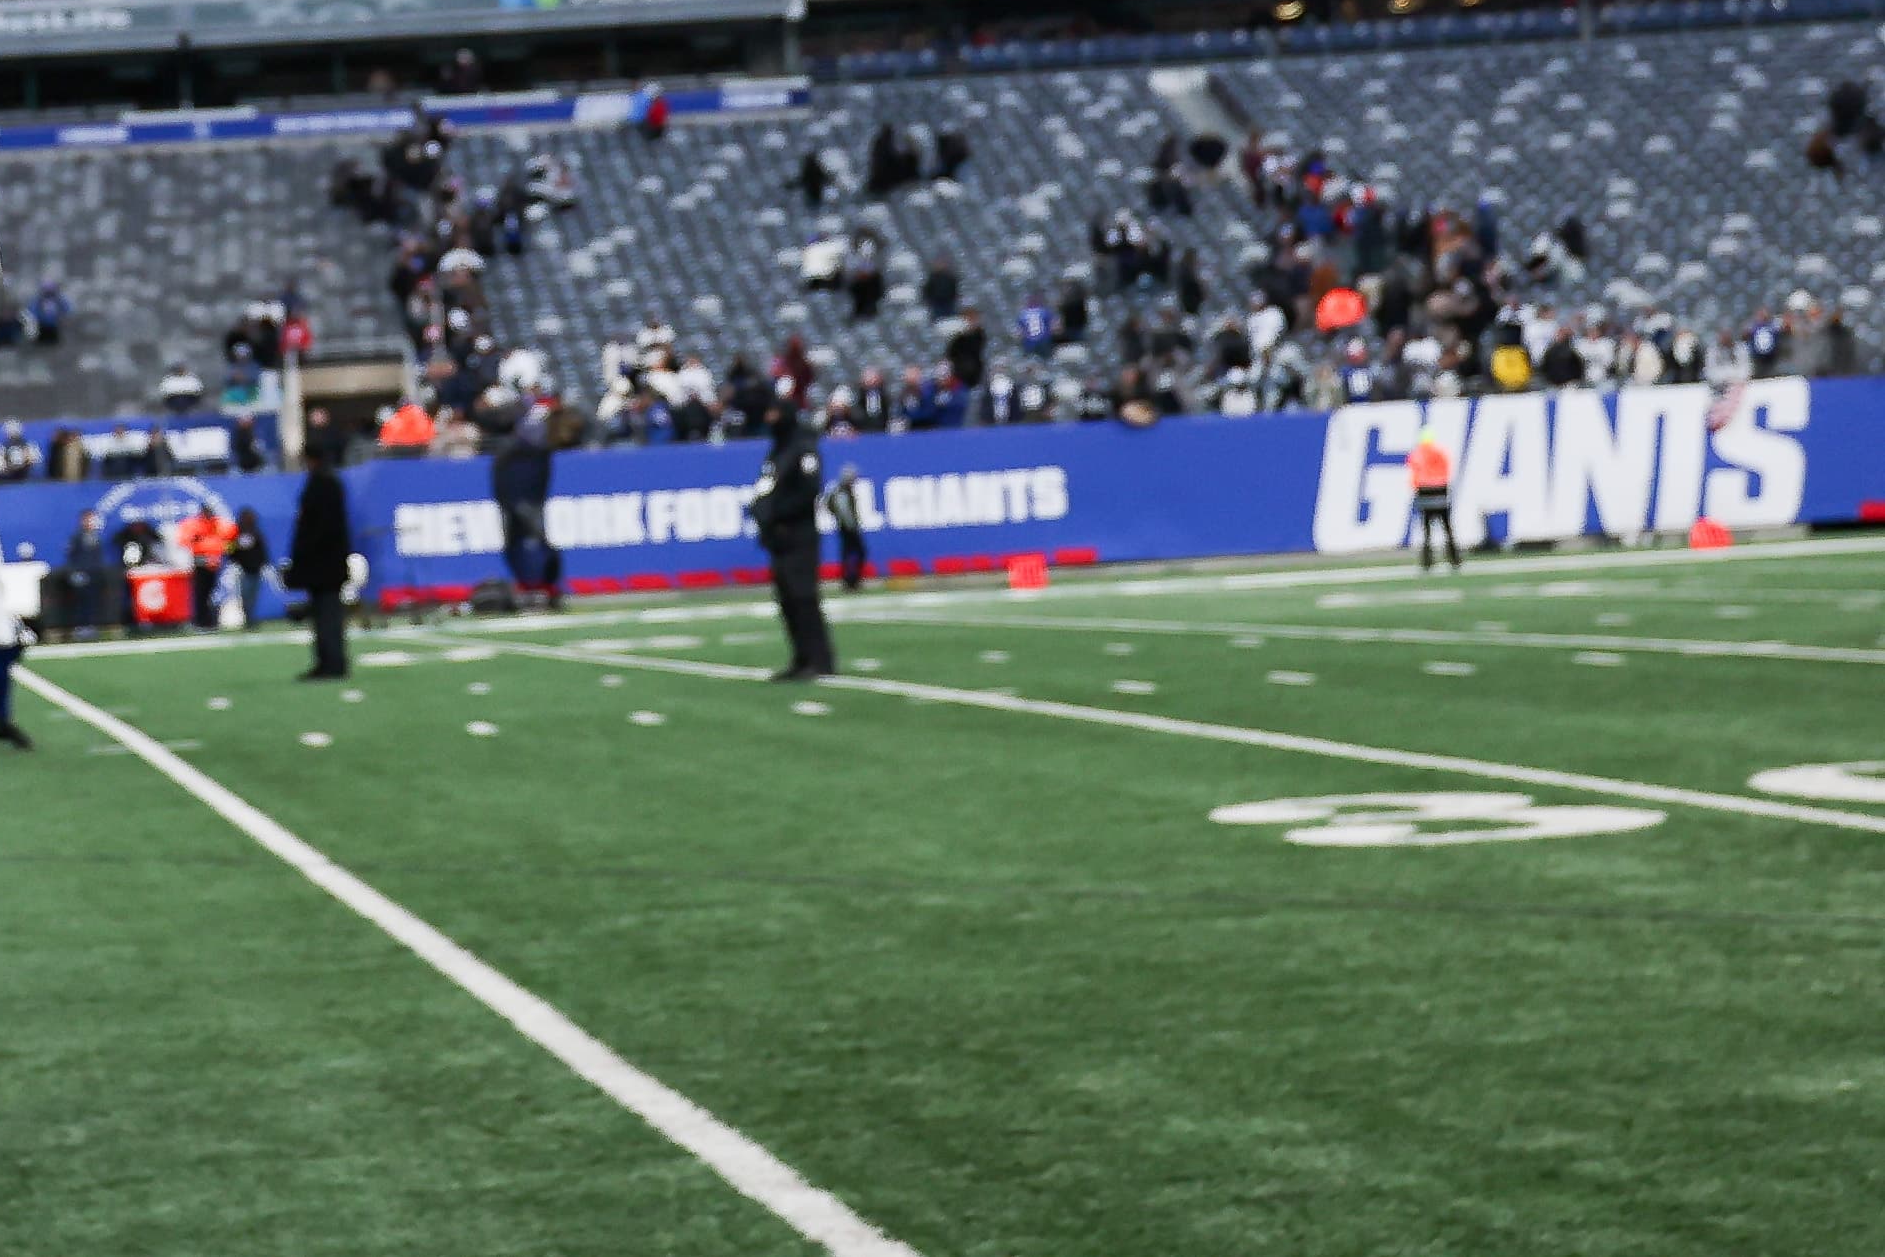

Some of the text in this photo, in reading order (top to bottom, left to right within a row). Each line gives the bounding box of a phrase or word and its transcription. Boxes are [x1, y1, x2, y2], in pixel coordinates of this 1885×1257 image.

[543, 491, 646, 551] ORK
[884, 465, 1067, 529] GIANTS
[1312, 377, 1811, 553] GIANTS
